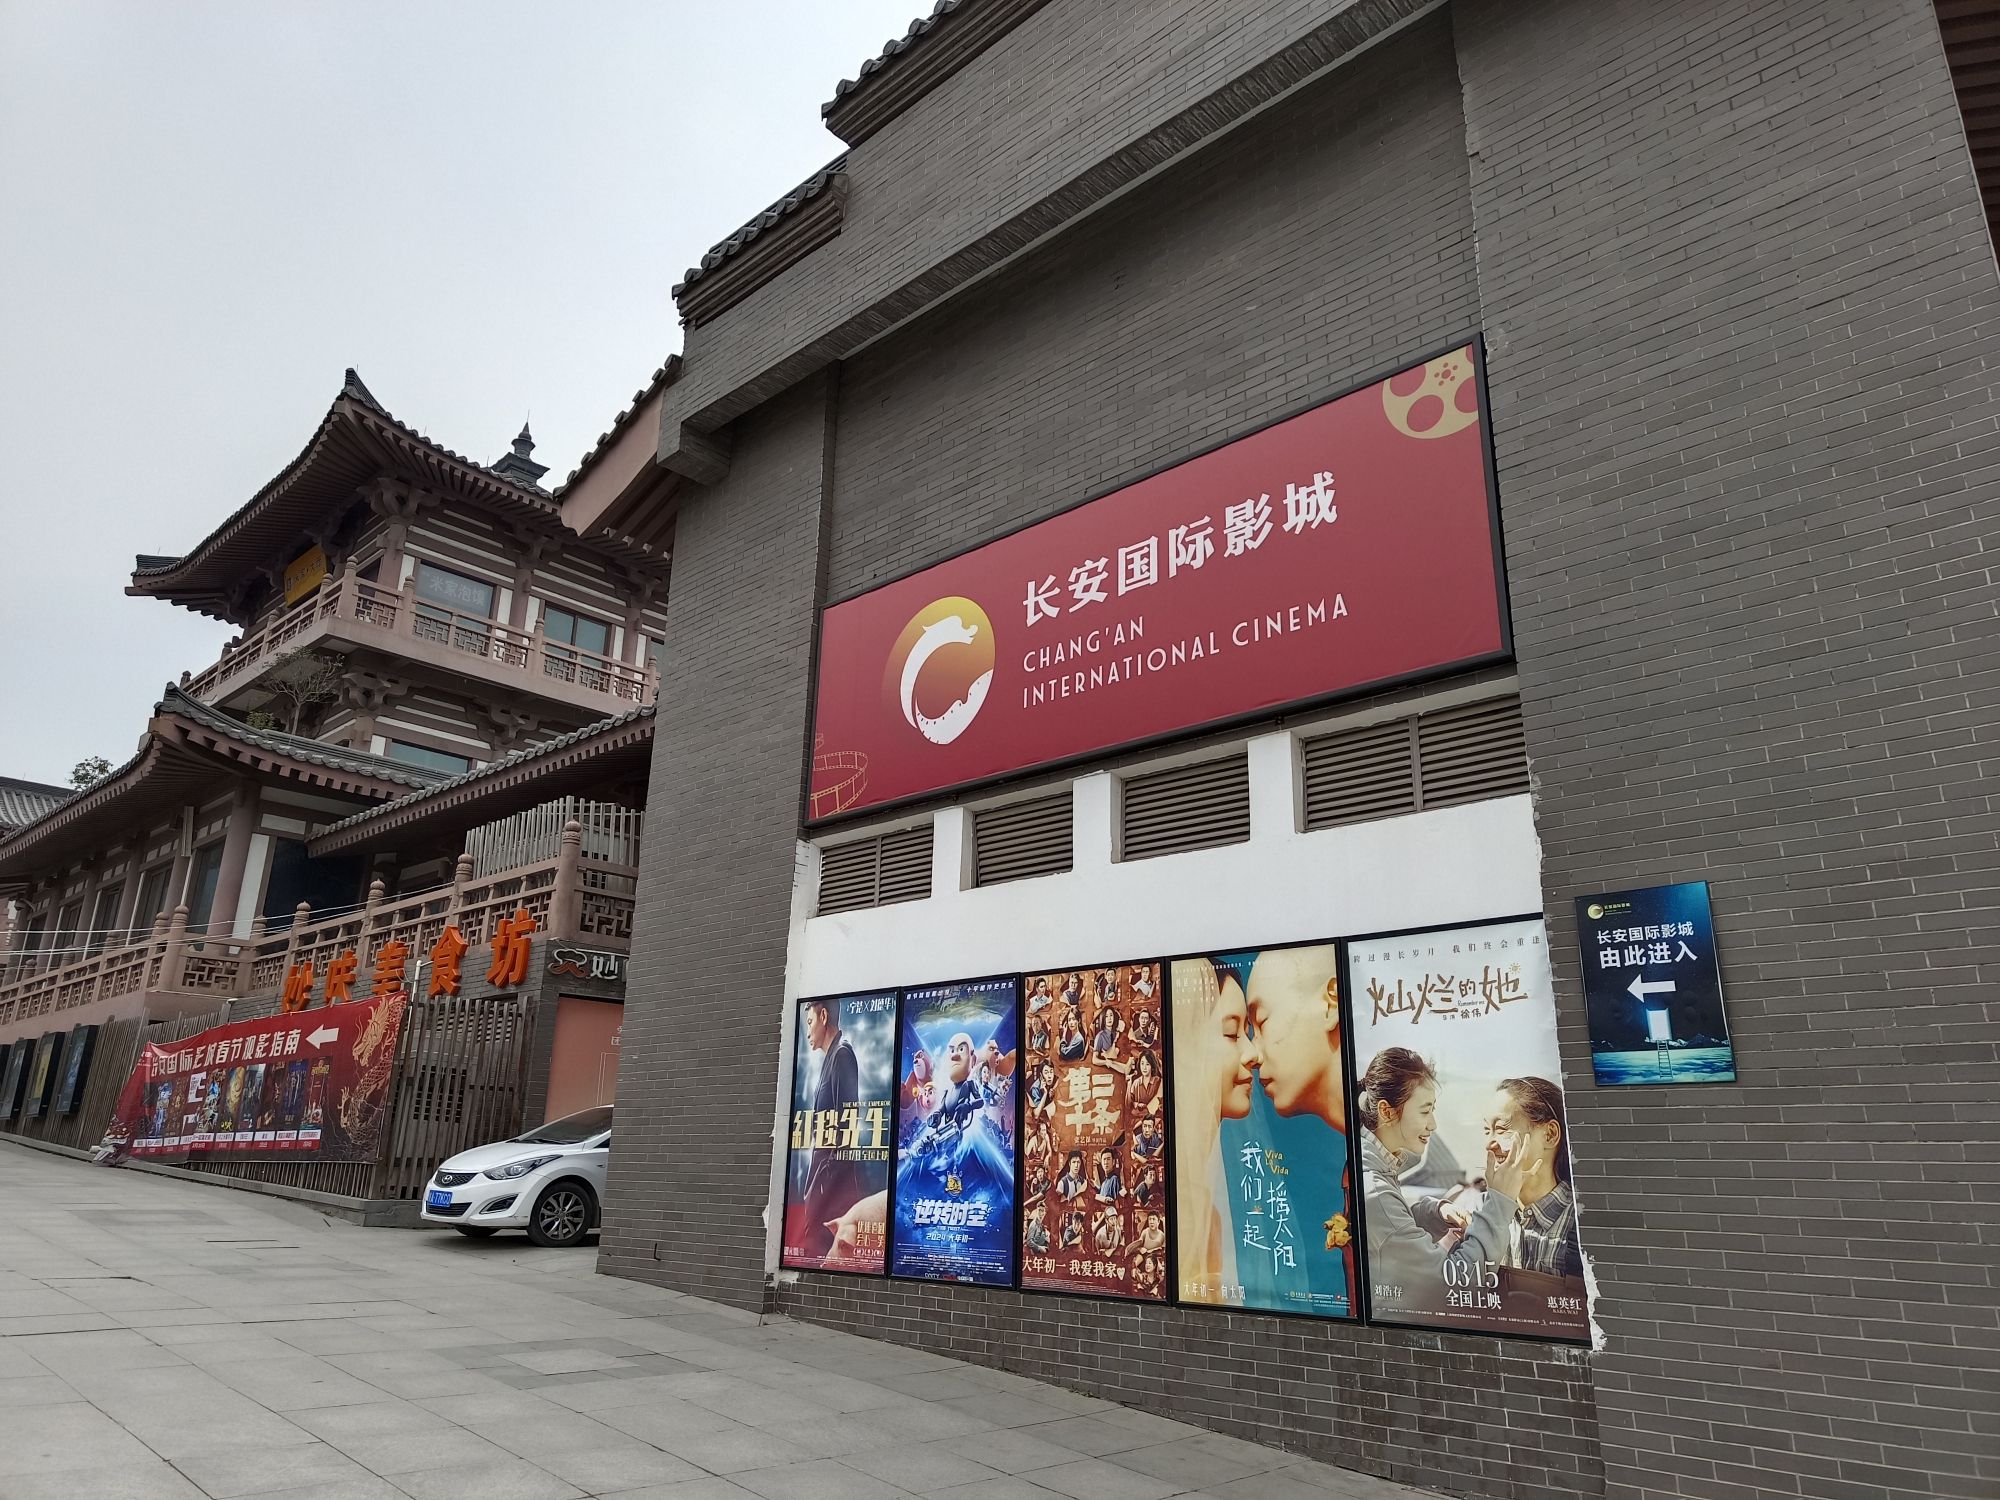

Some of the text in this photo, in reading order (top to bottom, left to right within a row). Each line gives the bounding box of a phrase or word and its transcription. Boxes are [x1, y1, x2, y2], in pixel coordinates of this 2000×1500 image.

[1022, 470, 1340, 628] 长安国际影城
[1022, 592, 1350, 709] INTERNATIONAL CINEMA
[1023, 615, 1145, 673] CHANG'AN
[1596, 921, 1694, 945] 长安国际影城
[282, 908, 537, 1013] 妙味美食坊
[1353, 935, 1541, 964] 跨过漫长岁月 我们终会重逢
[1599, 940, 1698, 969] 由此进入
[1366, 965, 1529, 1026] 灿烂的她
[1460, 1008, 1482, 1019] 徐伟
[791, 1108, 889, 1149] 红毯先生
[1264, 1149, 1283, 1161] Viva
[1270, 1164, 1289, 1175] Vida
[1240, 1141, 1272, 1251] 我们一起
[914, 1199, 989, 1227] 逆转时空
[925, 1233, 946, 1241] 2024
[1266, 1181, 1297, 1276] 摇太阳
[1022, 1255, 1066, 1274] 大年初一
[1069, 1259, 1117, 1280] 我爱我家
[1183, 1282, 1246, 1300] 大年初一 向太阳
[1445, 1289, 1502, 1310] 全国上映
[1547, 1295, 1582, 1311] 惠英红
